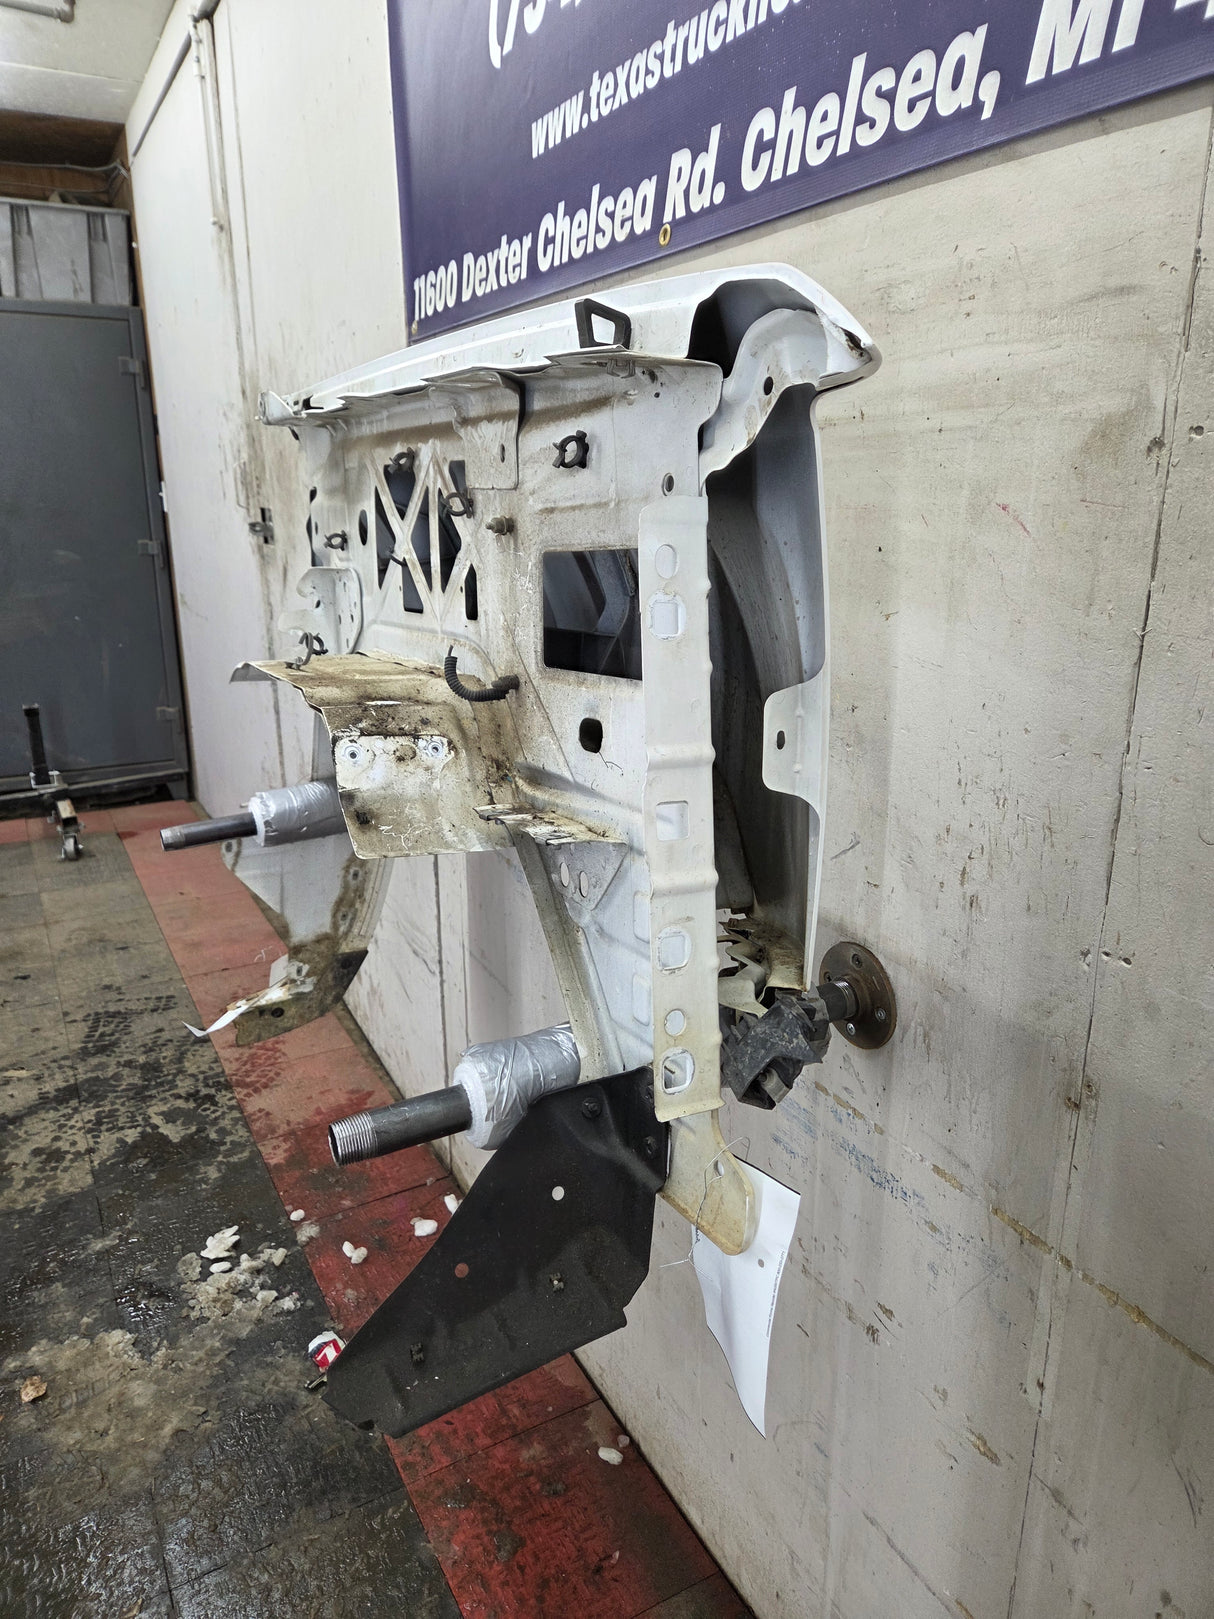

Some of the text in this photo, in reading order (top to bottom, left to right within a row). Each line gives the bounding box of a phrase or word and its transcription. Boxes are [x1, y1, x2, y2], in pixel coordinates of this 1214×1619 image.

[413, 259, 457, 321] 11600
[461, 232, 532, 303] Dexter
[536, 175, 658, 273] Chelsea
[662, 123, 726, 224] Rd.
[741, 23, 1000, 192] Chelsea,
[531, 0, 800, 159] www.texastruck
